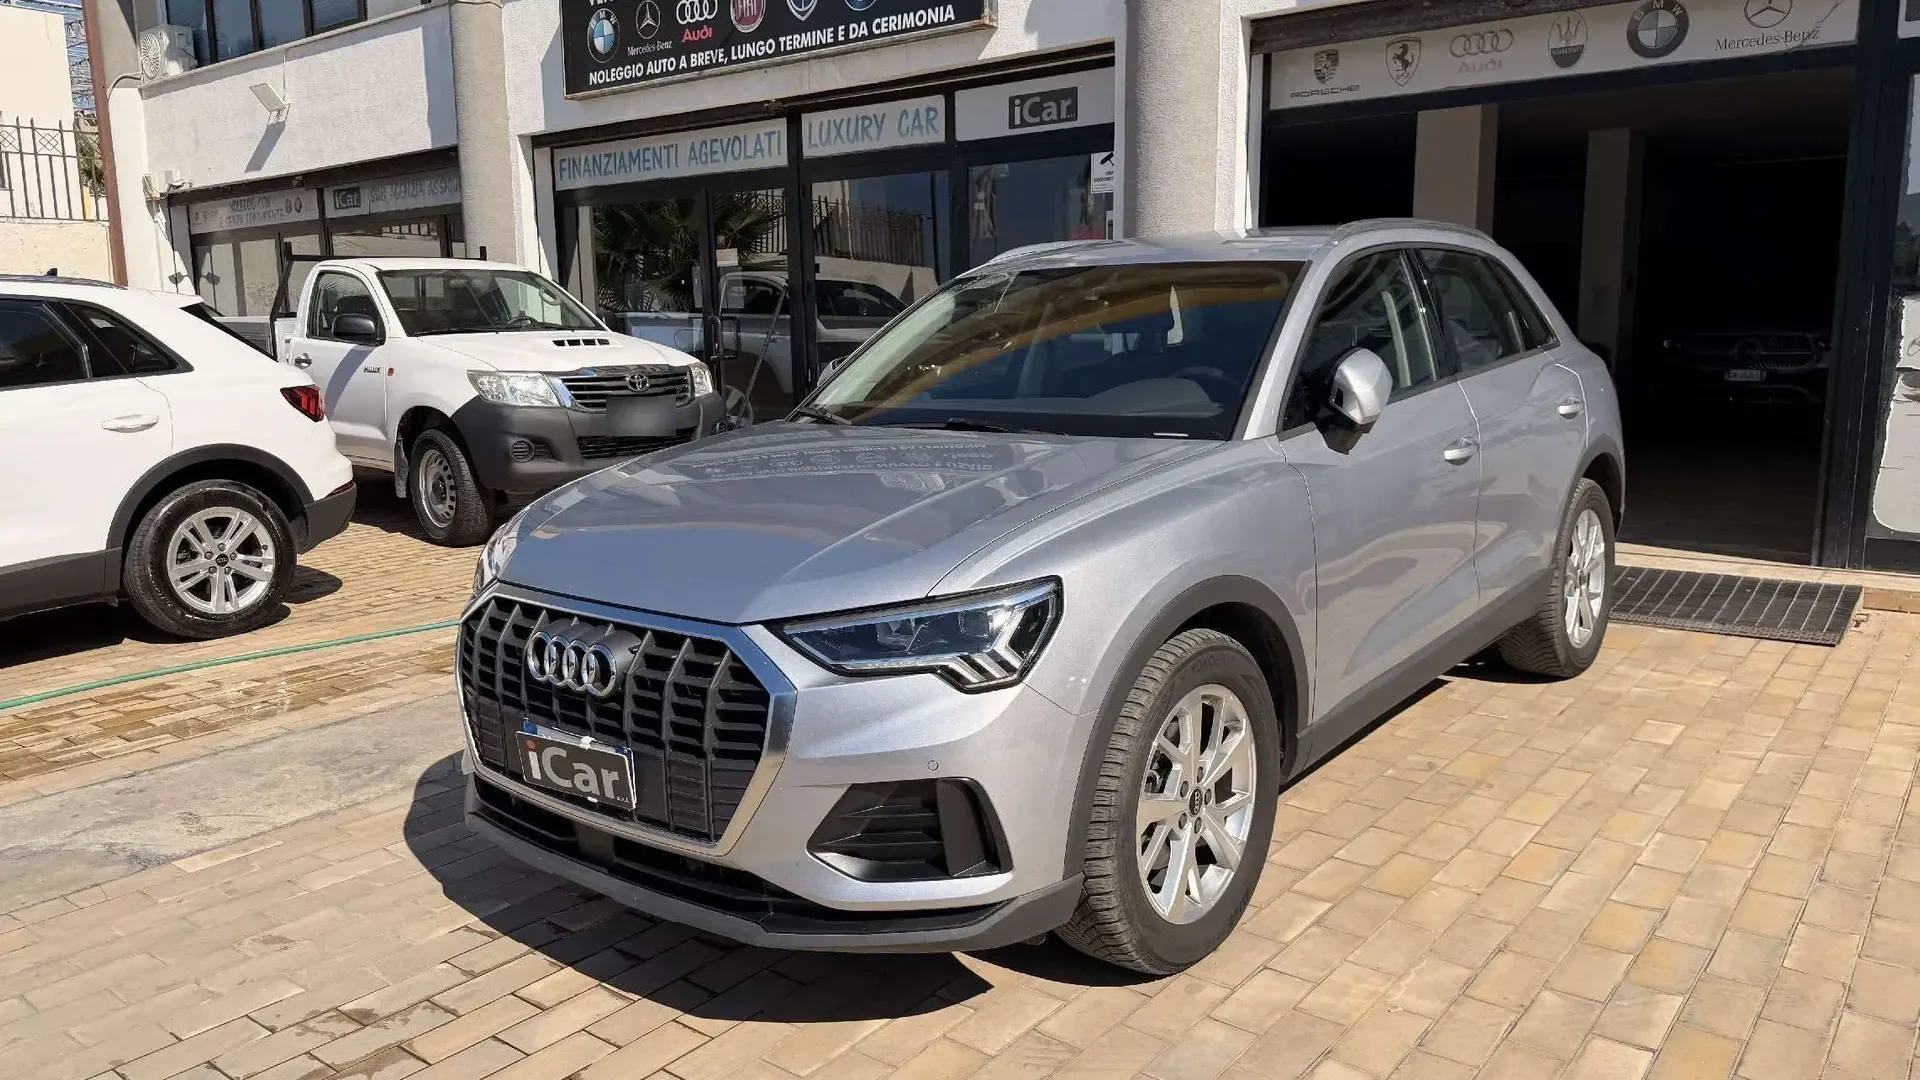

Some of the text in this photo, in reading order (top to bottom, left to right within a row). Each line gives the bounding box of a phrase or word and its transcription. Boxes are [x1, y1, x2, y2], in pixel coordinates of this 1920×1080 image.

[1634, 0, 1684, 20] BMW
[589, 4, 955, 85] NOLEGGIO AUTO A BREVE, LUNGO TERMINE E DA CERIMONIA
[682, 25, 713, 43] Audi
[1715, 28, 1820, 51] Mercedes-Benz
[627, 40, 673, 57] Mercedes-Benz
[1290, 84, 1360, 98] PORSCHE
[1014, 96, 1072, 125] iCar
[808, 106, 939, 149] LUXURY CAR
[559, 130, 782, 181] FINANZIAMENTI AGEVOLATI
[335, 191, 358, 208] iCar
[525, 740, 619, 799] iCar
